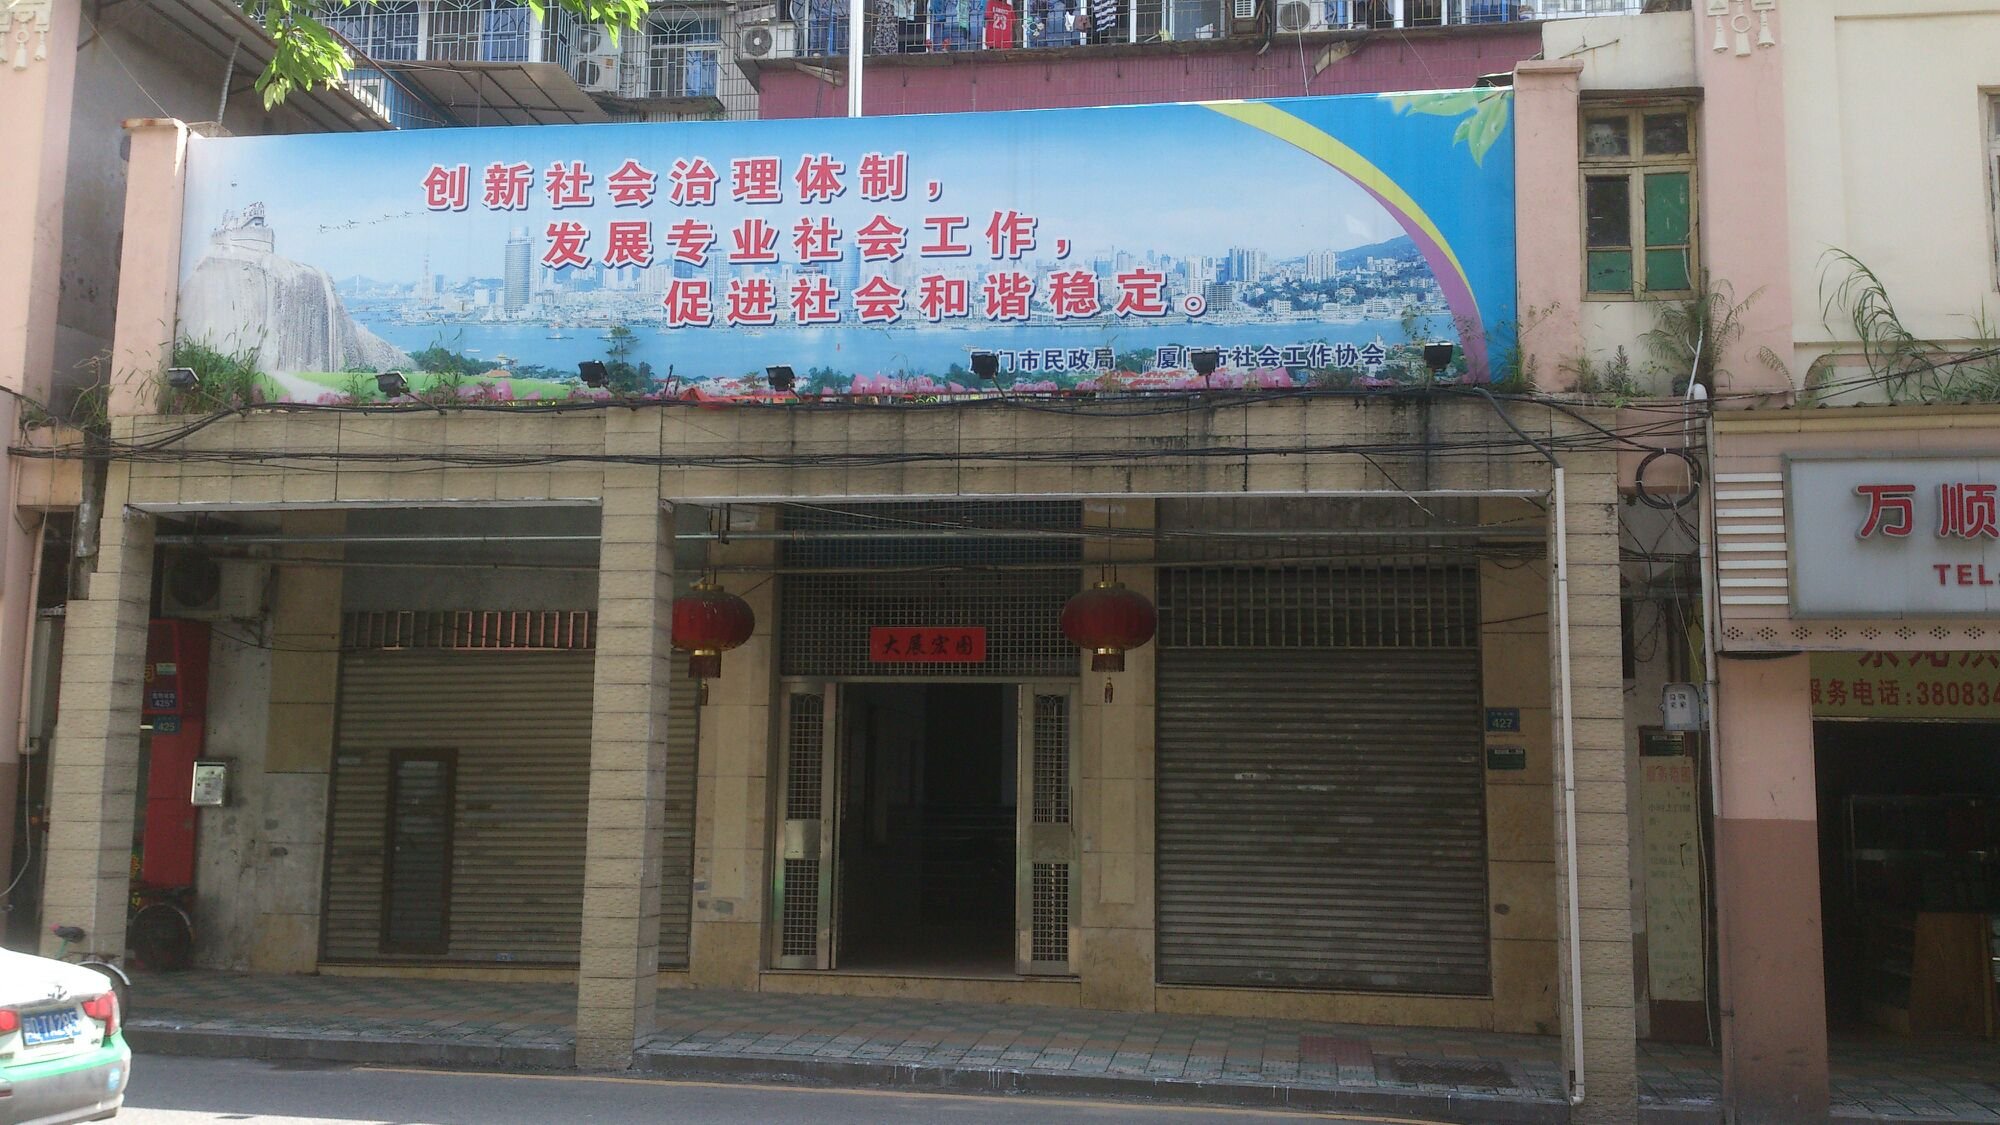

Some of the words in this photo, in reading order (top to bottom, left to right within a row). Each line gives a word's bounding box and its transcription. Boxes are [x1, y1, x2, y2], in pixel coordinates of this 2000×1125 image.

[993, 14, 1007, 30] 23
[422, 152, 943, 212] 创新社会治理体制，
[542, 209, 1072, 269] 发展专业社会工作，
[664, 267, 1208, 327] 促进社会和谐稳定。
[970, 347, 1115, 373] 门市民政局
[1855, 482, 2000, 539] 万顺
[882, 633, 974, 656] 大展宏图
[158, 722, 176, 731] 425
[1492, 718, 1513, 729] 427
